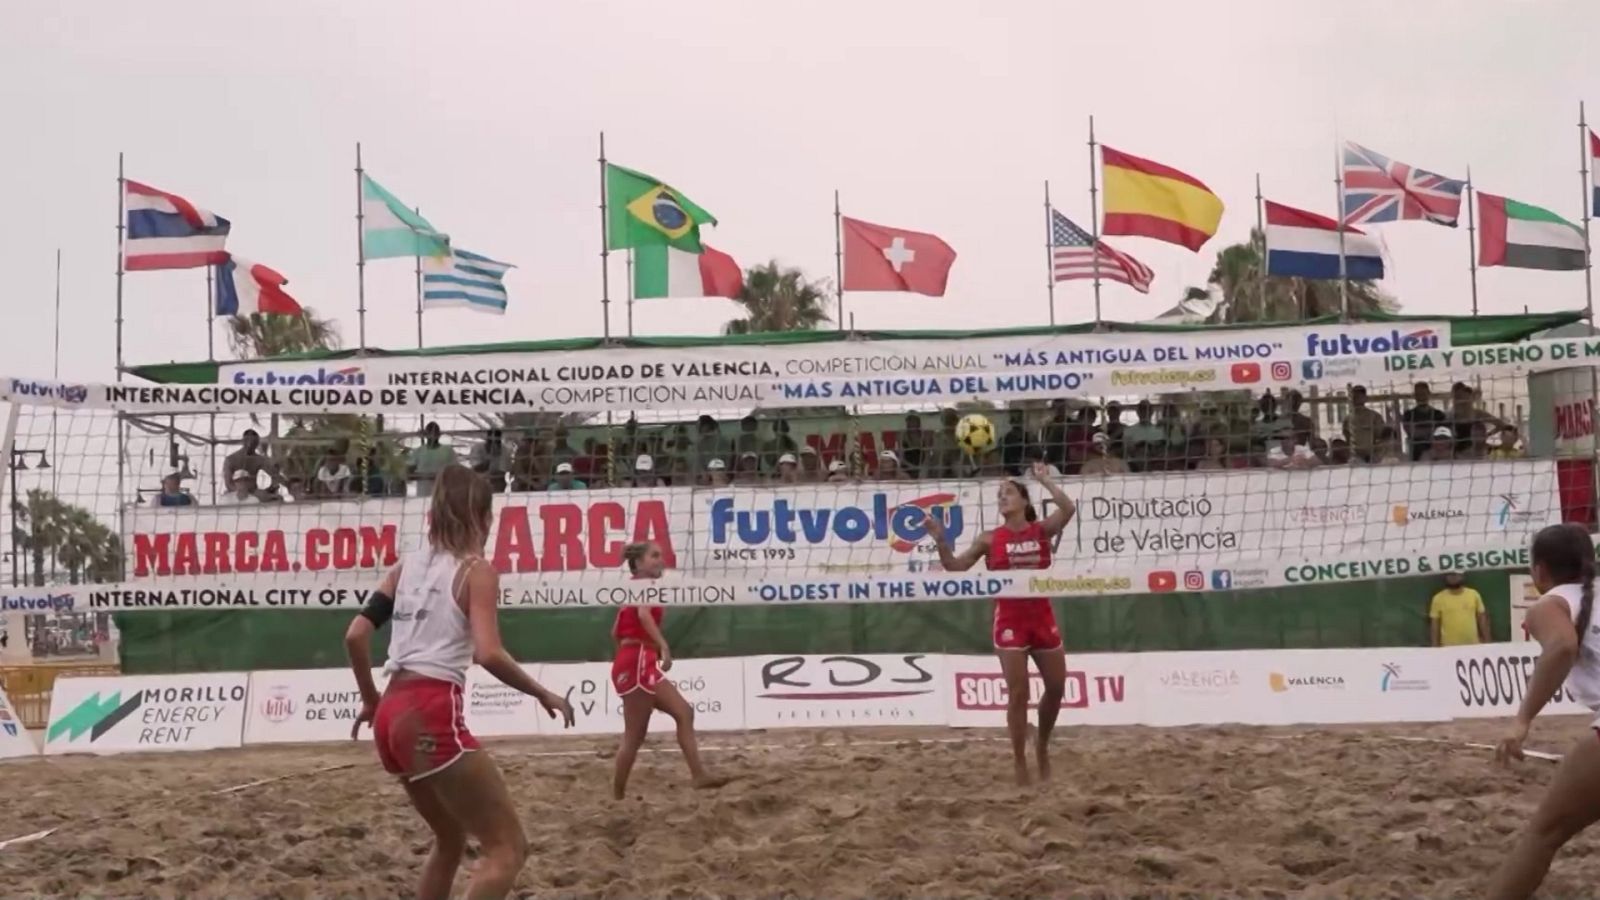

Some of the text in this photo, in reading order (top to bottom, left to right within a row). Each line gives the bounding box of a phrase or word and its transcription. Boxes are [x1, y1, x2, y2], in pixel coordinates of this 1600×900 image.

[1307, 330, 1438, 356] futvoley
[1384, 354, 1434, 371] IDEA
[1442, 352, 1452, 366] Y
[1550, 342, 1578, 359] DE
[388, 369, 550, 386] INTERNACIONAL
[557, 365, 634, 381] CIUDAD
[641, 363, 665, 378] DE
[672, 361, 779, 378] VALENCIA,
[923, 354, 987, 370] ANUAL
[1055, 347, 1147, 365] ANTIGUA
[1154, 347, 1188, 361] DEL
[106, 387, 282, 405] INTERNACIONAL
[289, 388, 373, 405] CIUDAD
[380, 389, 408, 405] DE
[415, 388, 534, 407] VALENCIA,
[693, 384, 764, 401] ANUAL
[840, 376, 942, 398] ANTIGUA
[950, 376, 989, 394] DEL
[1092, 492, 1211, 524] Diputació
[490, 500, 676, 574] ARCA
[711, 493, 964, 553] futvoley
[134, 523, 398, 577] MARCA.COM
[1094, 526, 1236, 553] de València
[713, 548, 795, 561] SINCE 1993
[1285, 558, 1410, 583] CONCEIVED
[1418, 555, 1432, 573] &
[1440, 548, 1529, 570] DESIGNE
[89, 589, 259, 607] INTERNATIONAL
[269, 589, 309, 606] CITY
[318, 588, 346, 605] OF
[520, 587, 589, 606] ANUAL
[596, 585, 735, 605] COMPETITION
[850, 583, 869, 599] IN
[877, 581, 914, 597] THE
[762, 656, 932, 689] RDS
[1456, 655, 1538, 707] SCOOTE
[143, 685, 244, 703] MORILLO
[306, 691, 362, 703] AJUNT
[1095, 675, 1124, 702] TV
[142, 705, 225, 724] ENERGY
[306, 708, 327, 720] DE
[138, 726, 195, 744] RENT
